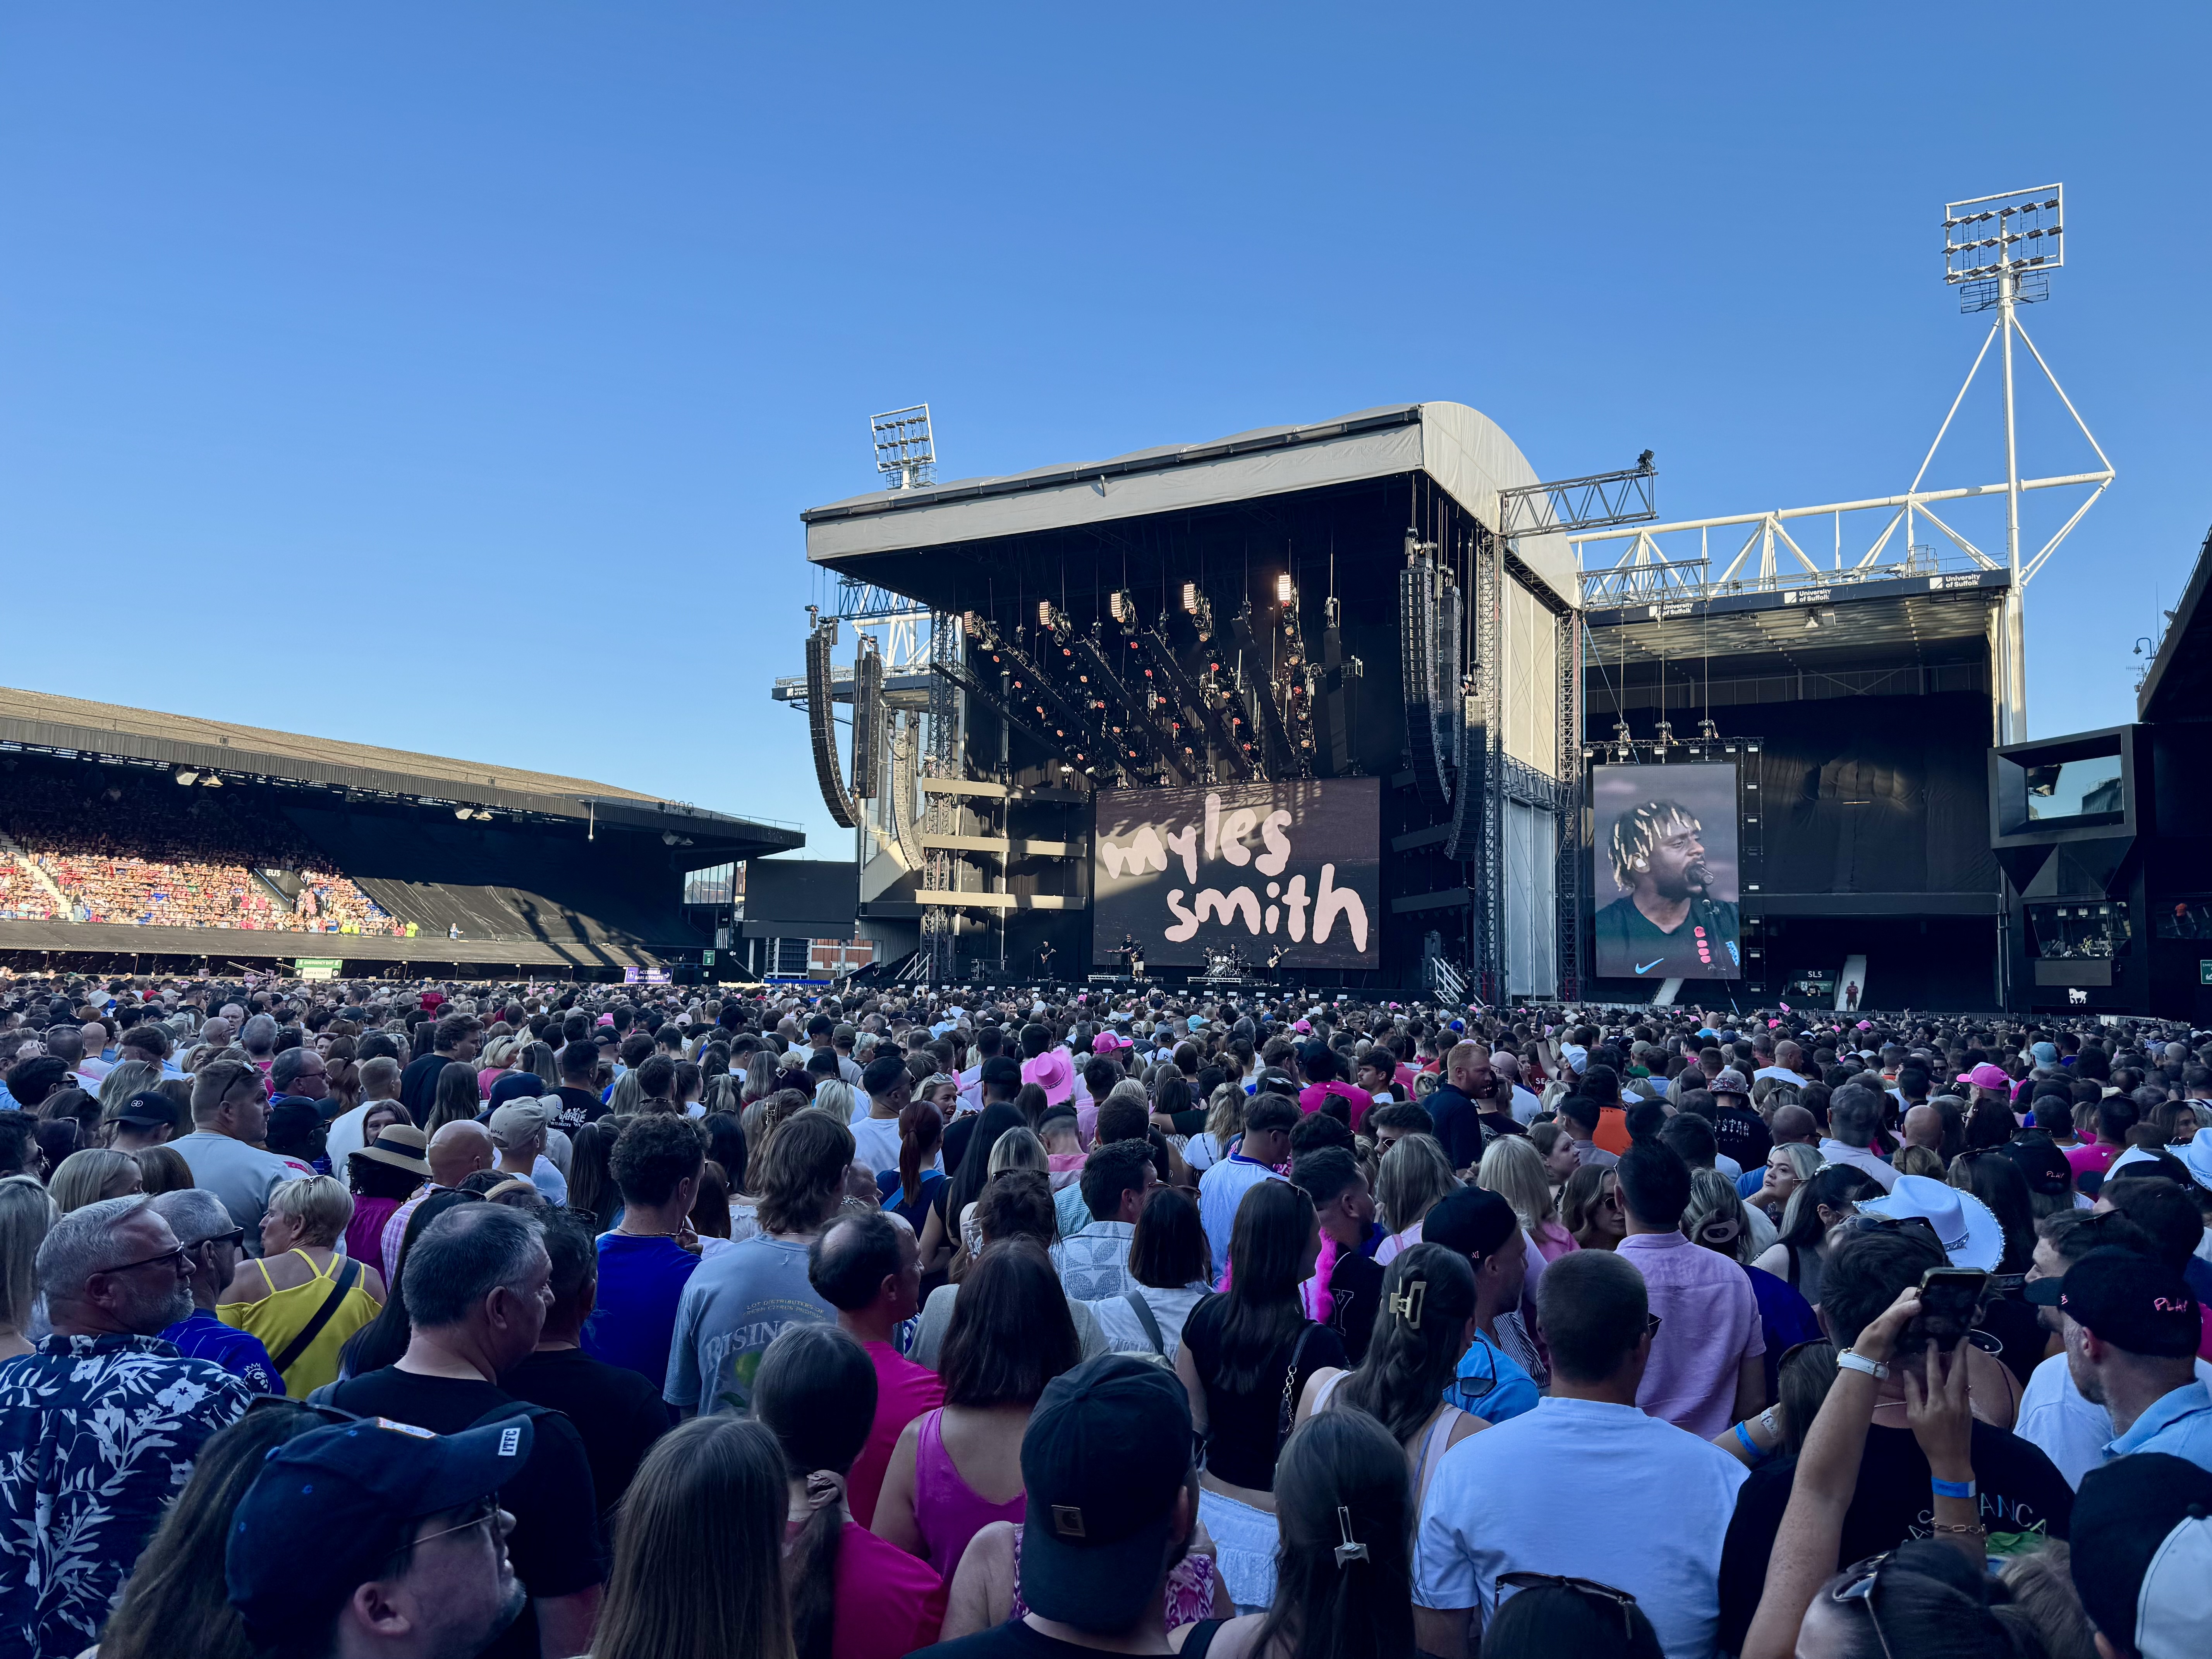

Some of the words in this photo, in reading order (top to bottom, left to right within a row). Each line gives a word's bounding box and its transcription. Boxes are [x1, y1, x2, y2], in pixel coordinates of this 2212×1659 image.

[1946, 574, 1980, 582] University
[1101, 793, 1292, 884] myles
[1164, 863, 1368, 952] smith
[502, 1431, 517, 1451] ITFC
